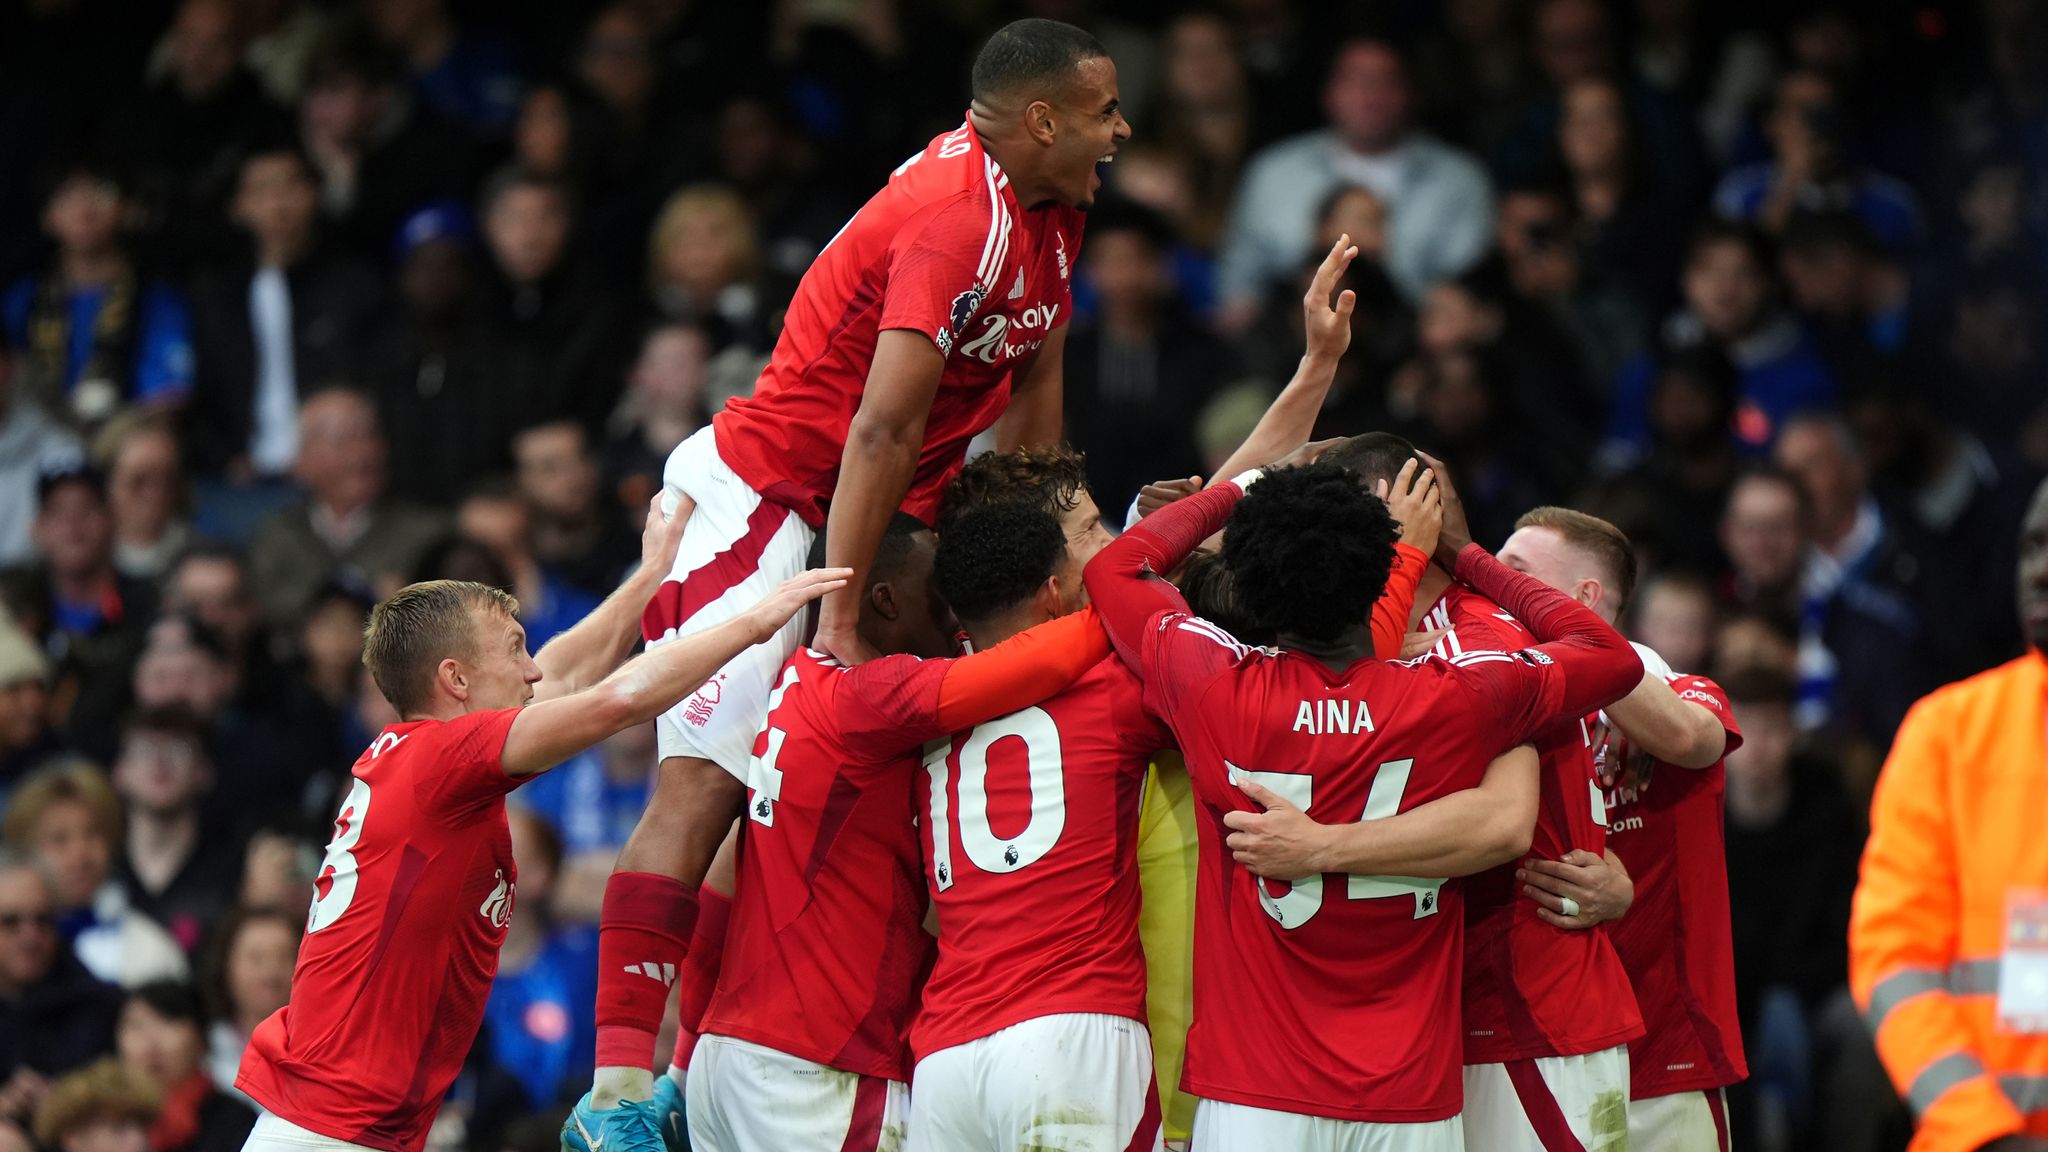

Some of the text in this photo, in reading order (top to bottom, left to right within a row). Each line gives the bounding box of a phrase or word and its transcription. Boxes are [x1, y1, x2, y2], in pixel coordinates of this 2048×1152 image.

[683, 710, 708, 728] FOREST
[1292, 699, 1375, 735] AINA
[922, 705, 1067, 894] 10
